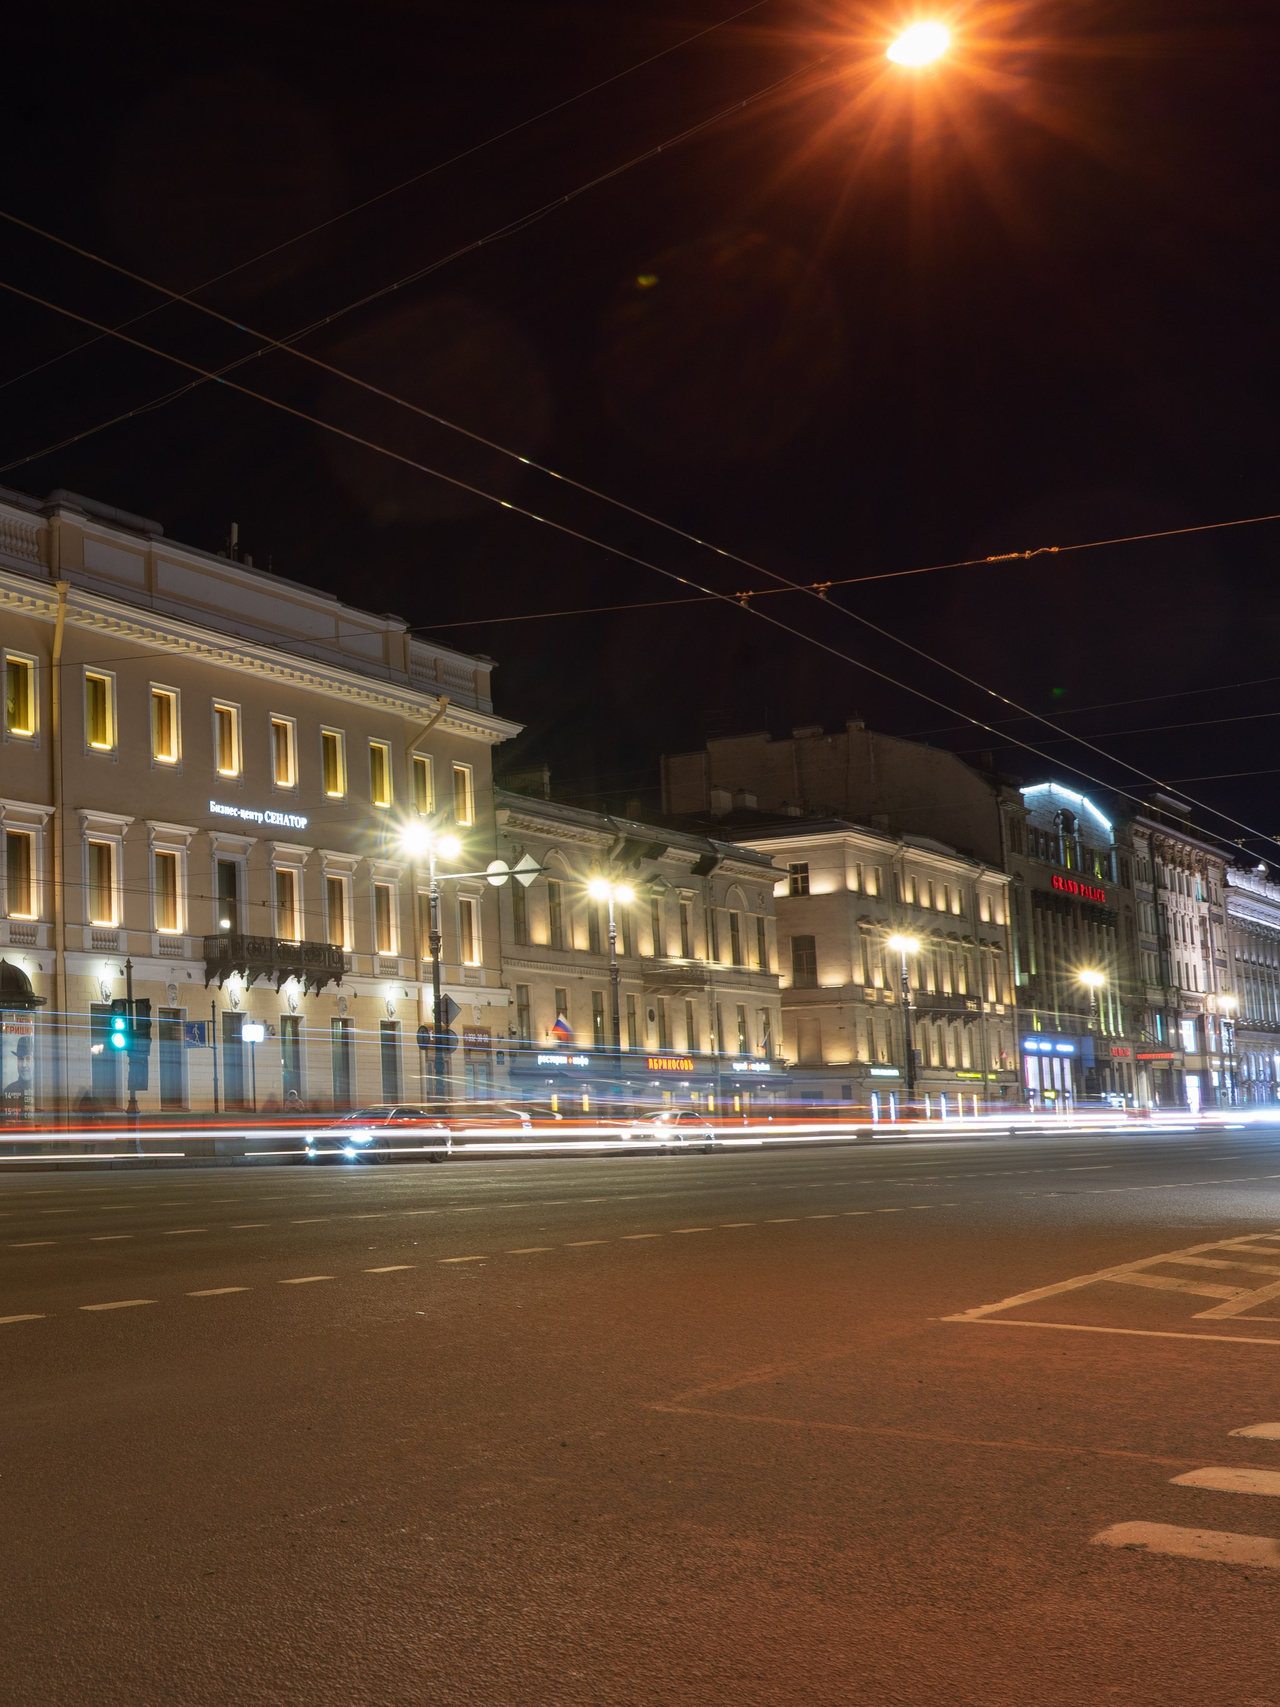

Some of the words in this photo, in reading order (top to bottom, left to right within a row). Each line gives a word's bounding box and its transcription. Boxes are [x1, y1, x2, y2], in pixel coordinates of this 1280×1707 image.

[209, 800, 263, 824] Бизнес-центр
[264, 811, 308, 829] СЕНАТОР
[1052, 875, 1078, 895] GRAND
[1080, 883, 1106, 903] PALACE
[647, 1057, 695, 1071] АБРИКОСОВЪ
